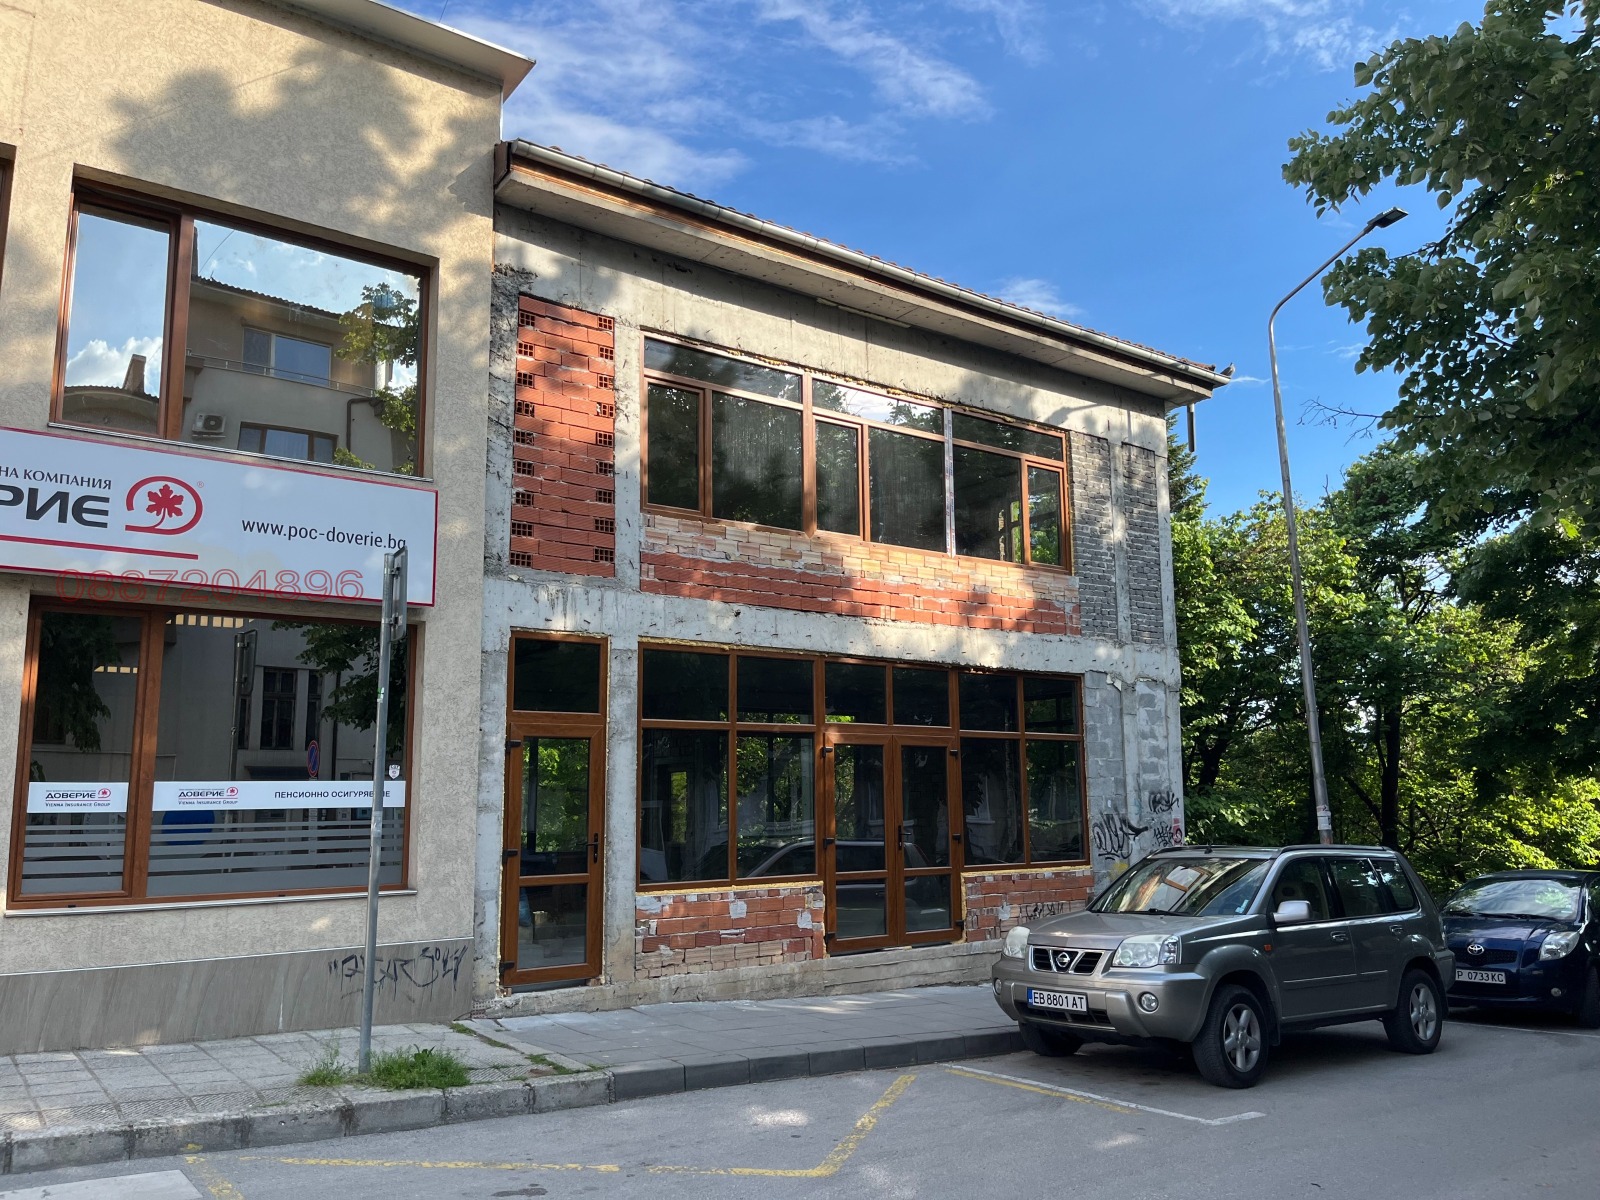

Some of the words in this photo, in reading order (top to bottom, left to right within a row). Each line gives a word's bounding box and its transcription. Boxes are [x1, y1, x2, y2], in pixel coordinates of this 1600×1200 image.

[23, 469, 112, 490] КОМПАНИЯ
[242, 519, 406, 550] www.poc-doverie.bg
[178, 790, 224, 798] ДОВЕРИЕ
[274, 791, 329, 799] ПЕНСИОННО
[331, 790, 391, 799] ОСИГУРЯВЕ
